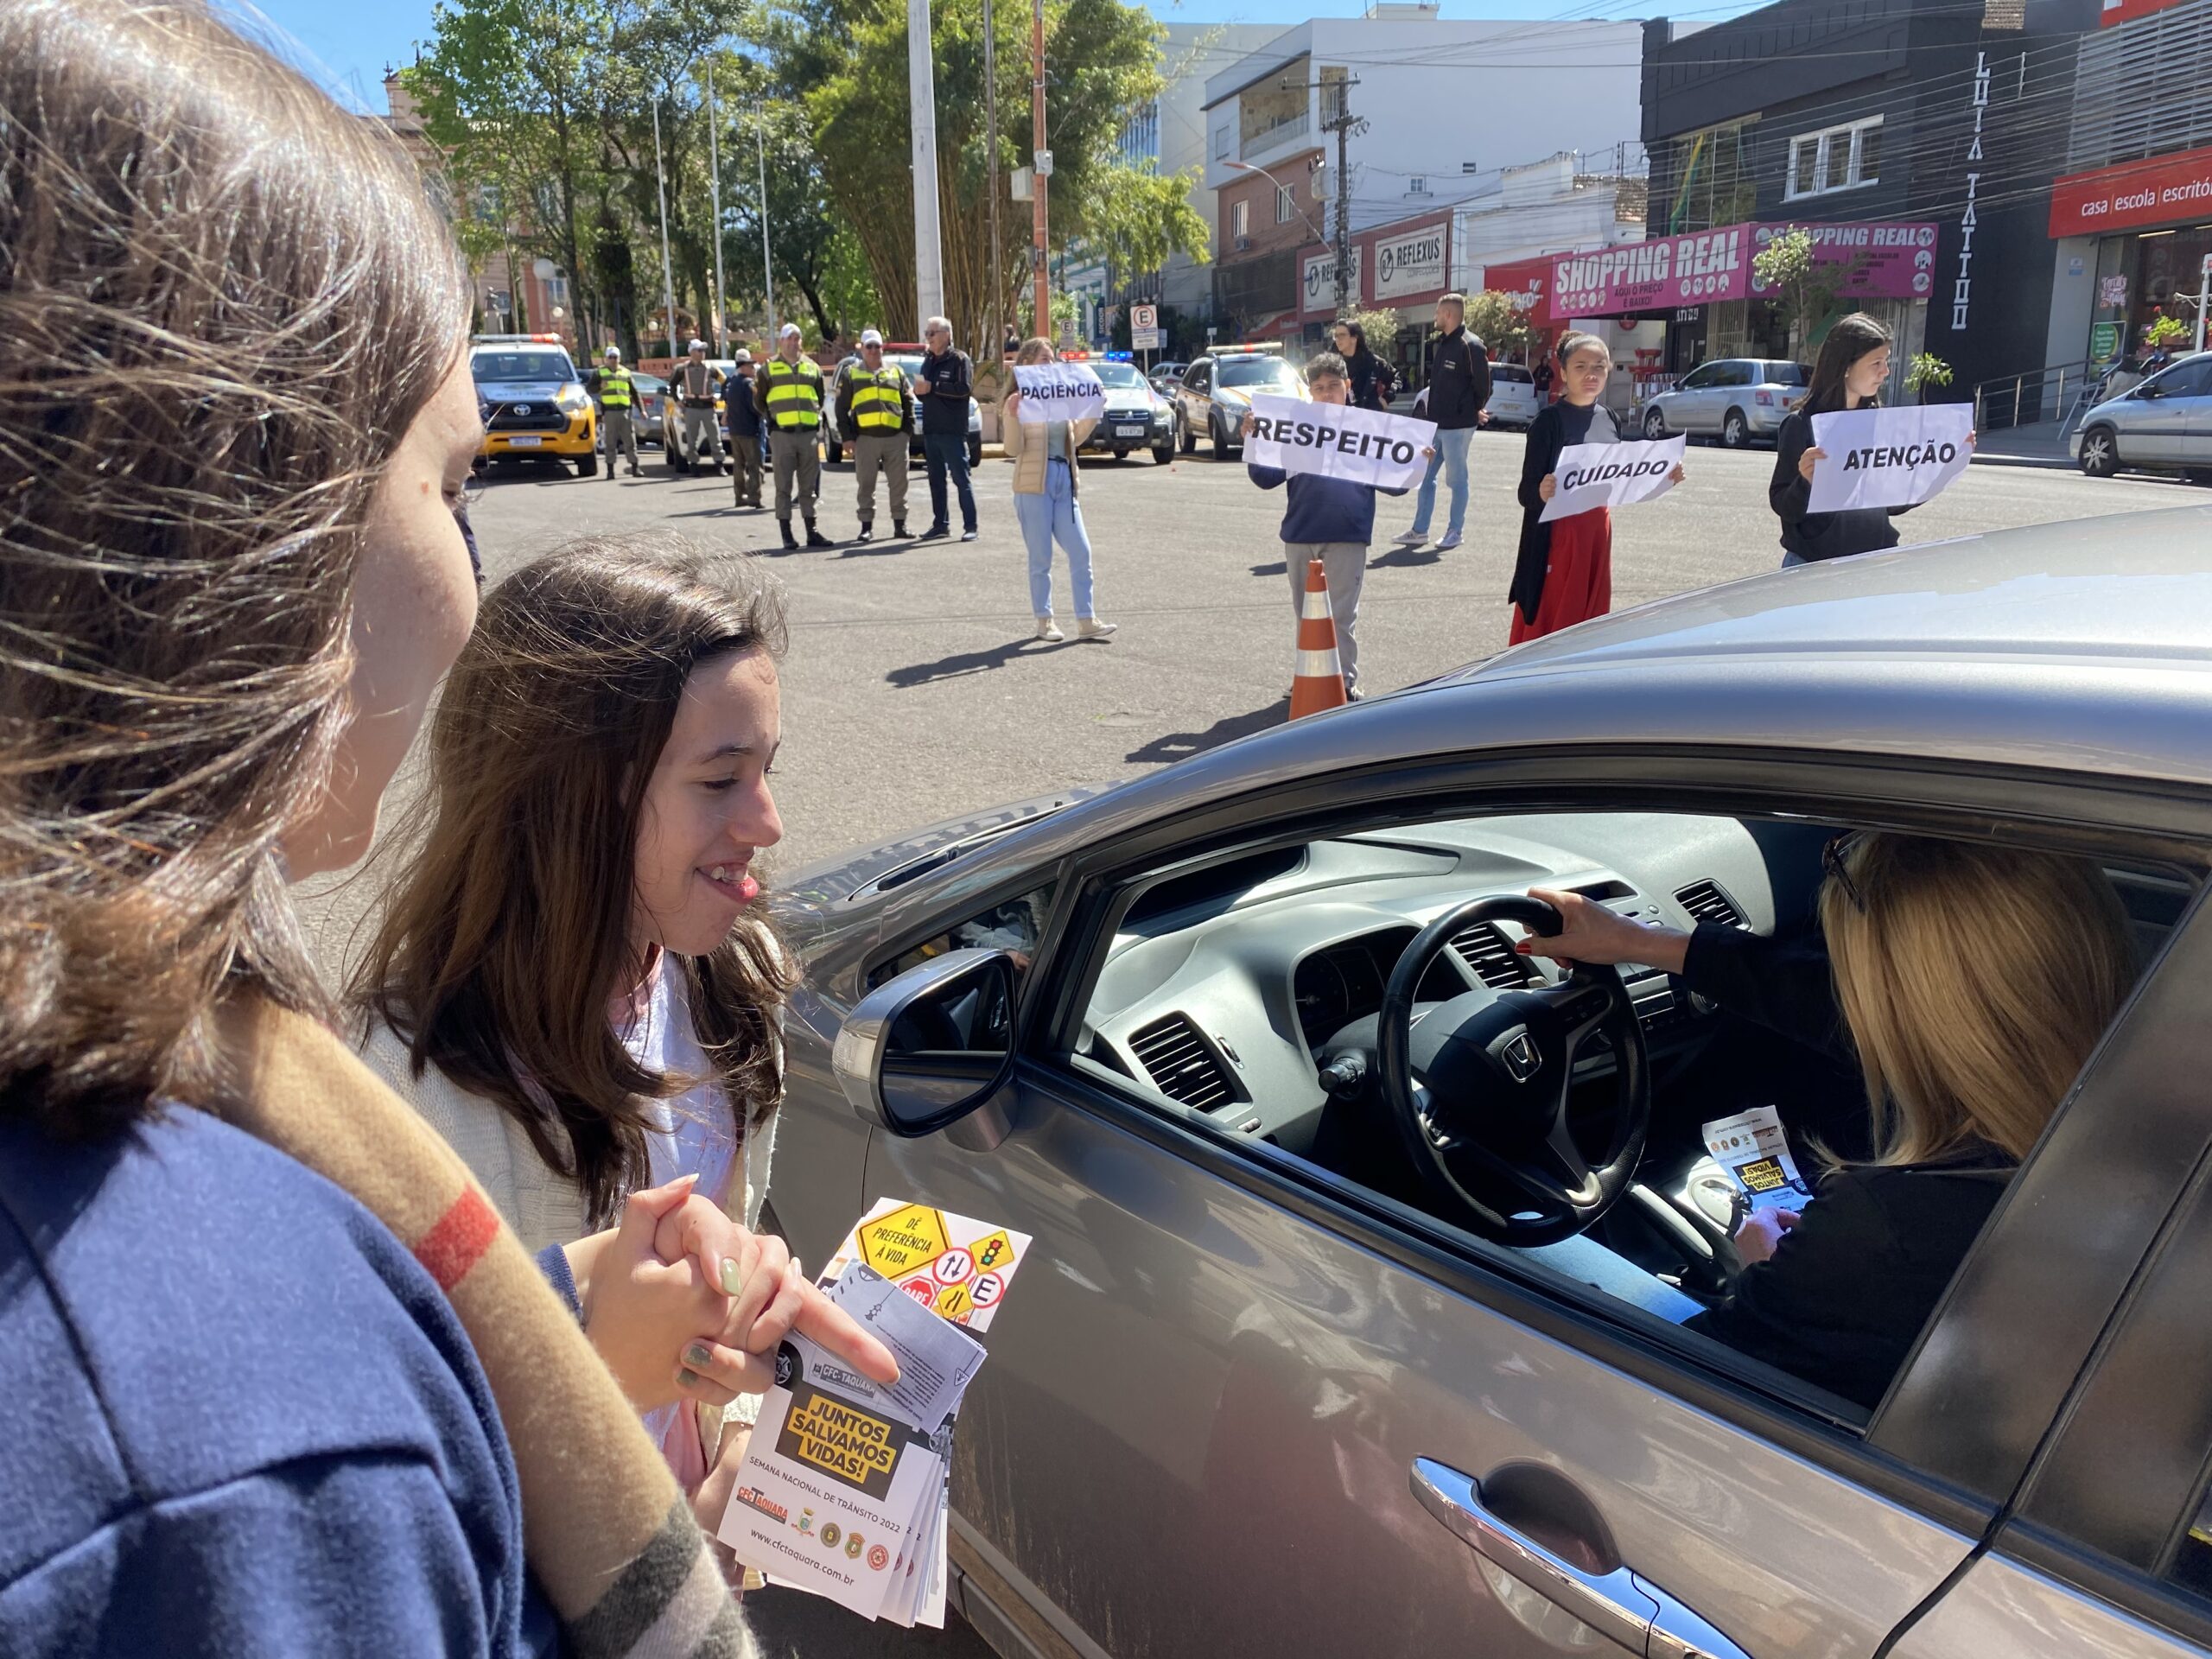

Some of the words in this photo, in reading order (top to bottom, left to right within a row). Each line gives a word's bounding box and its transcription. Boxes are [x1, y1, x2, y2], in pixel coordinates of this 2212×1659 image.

[2082, 200, 2108, 217] casa
[2114, 188, 2155, 211] escola
[1872, 227, 1916, 246] REAL
[1396, 237, 1440, 267] REFLEXUS
[1556, 242, 1671, 295] SHOPPING
[1675, 230, 1740, 278] REAL
[1951, 173, 1981, 330] TATTOO
[1614, 287, 1631, 297] AQUI
[1631, 286, 1637, 296] O
[1639, 283, 1664, 296] PREÇO
[1064, 321, 1070, 332] E
[1140, 310, 1149, 324] E
[1020, 381, 1102, 400] PACIÊNCIA
[1251, 416, 1414, 465] RESPEITO
[1843, 439, 1956, 471] ATENÇÃO
[1563, 460, 1669, 491] CUIDADO
[1744, 1168, 1782, 1184] SALVAMOS
[1753, 1178, 1781, 1189] JUNTOS
[906, 1217, 922, 1230] DÊ
[873, 1228, 932, 1255] PREFERÊNCIA
[875, 1244, 885, 1259] À
[886, 1249, 908, 1266] VIDA
[973, 1277, 996, 1302] E
[810, 1402, 886, 1443] JUNTOS
[792, 1414, 890, 1467] SALVAMOS
[807, 1439, 865, 1478] VIDAS!
[749, 1456, 780, 1478] SEMANA
[782, 1471, 822, 1497] NACIONAL
[823, 1492, 835, 1503] DE
[837, 1497, 879, 1523] TRÂNSITO
[880, 1518, 900, 1534] 2022
[751, 1529, 855, 1587] www.cfctaquara.com.br
